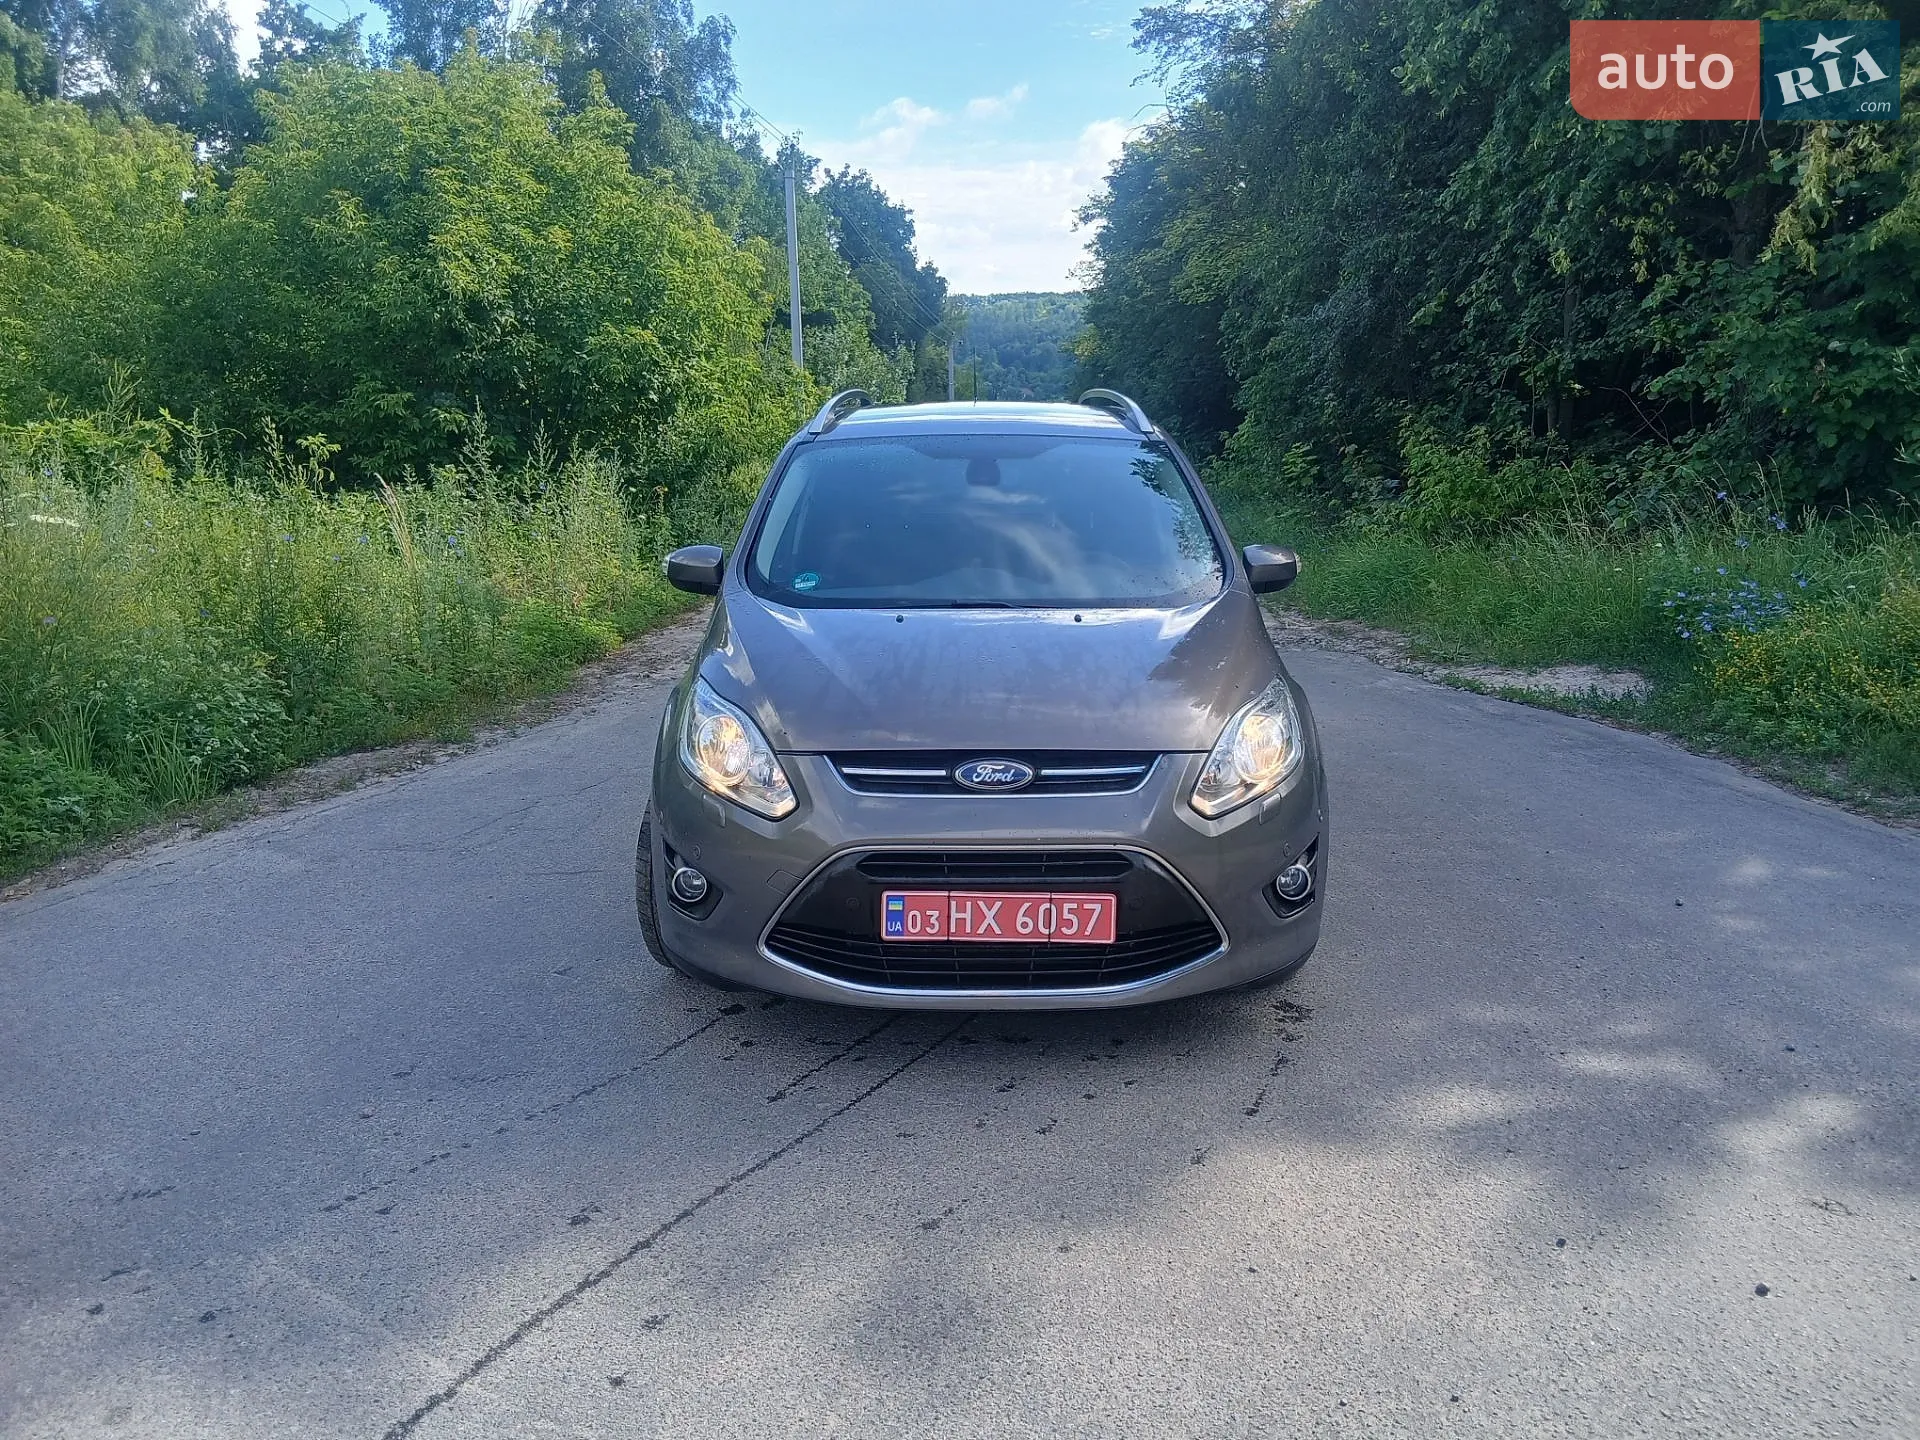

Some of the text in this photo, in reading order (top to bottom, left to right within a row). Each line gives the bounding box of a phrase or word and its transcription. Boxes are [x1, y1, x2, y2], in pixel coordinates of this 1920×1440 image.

[972, 764, 1016, 782] Ford
[888, 922, 903, 932] UA
[907, 900, 1102, 937] 03 HX 6057
